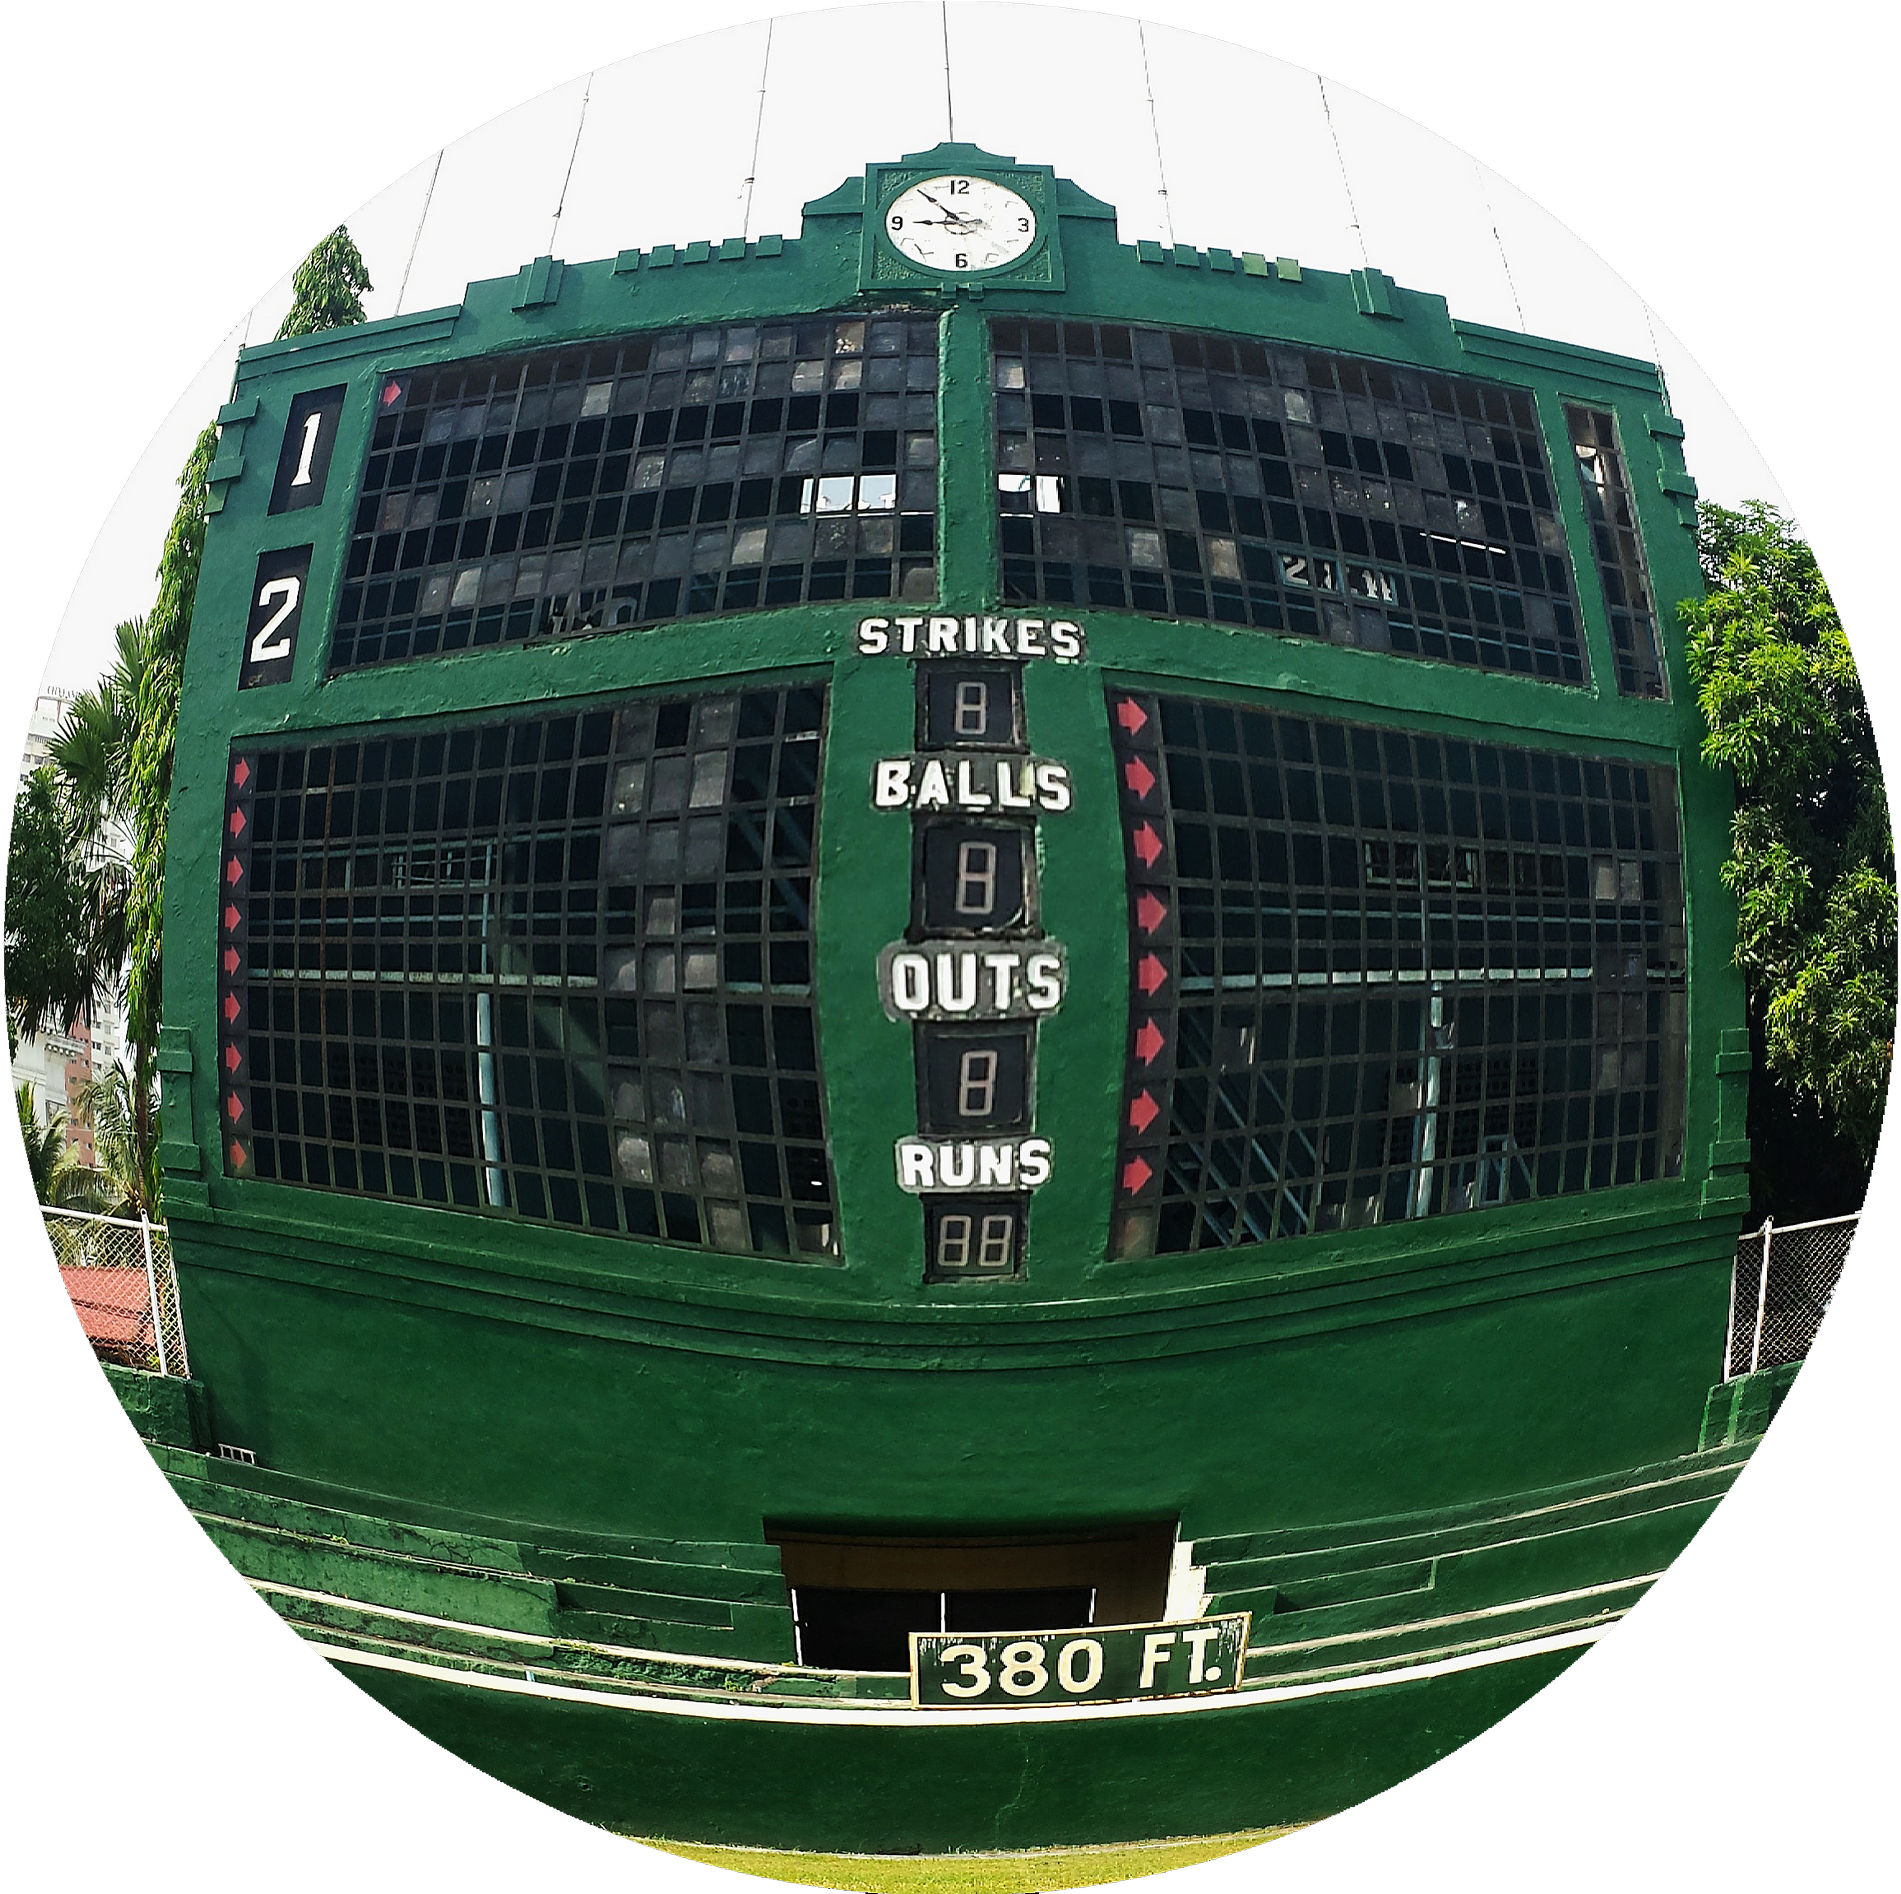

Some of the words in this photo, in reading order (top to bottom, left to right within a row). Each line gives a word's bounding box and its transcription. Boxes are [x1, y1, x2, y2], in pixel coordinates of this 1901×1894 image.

[950, 180, 970, 195] 12
[891, 216, 903, 231] 9
[1017, 217, 1029, 233] 3
[955, 253, 968, 269] 6
[291, 412, 322, 487] 1
[250, 576, 301, 663] 2
[859, 616, 1081, 658] STRIKES
[875, 759, 1071, 811] BALLS
[892, 953, 1061, 1012] OUTS
[901, 1139, 1051, 1187] RUNS
[940, 1638, 1104, 1698] 380
[1139, 1627, 1223, 1689] FT.
